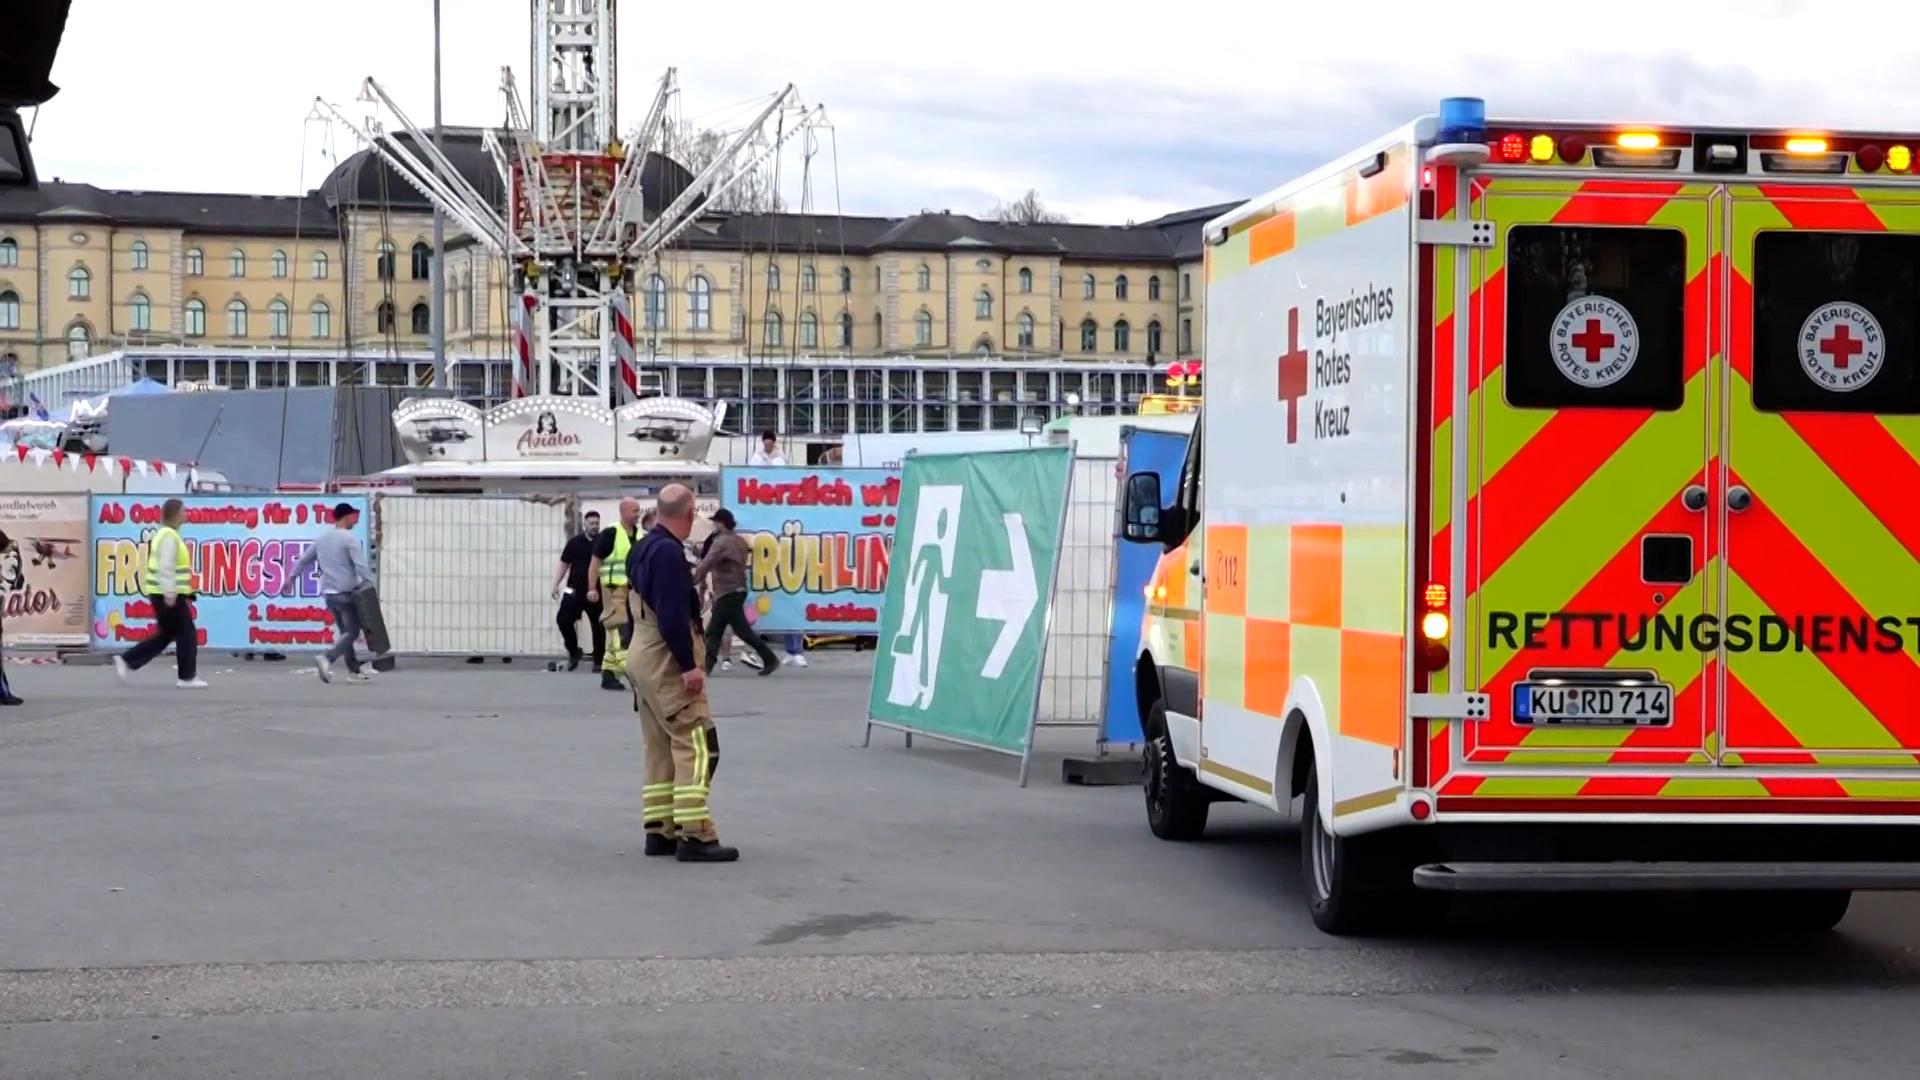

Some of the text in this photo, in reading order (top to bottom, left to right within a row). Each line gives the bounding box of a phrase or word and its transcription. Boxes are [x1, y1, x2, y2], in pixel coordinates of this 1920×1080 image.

[1316, 282, 1393, 343] Bayerisches
[1557, 303, 1632, 338] BAYERISCHES
[1805, 308, 1878, 343] BAYERISCHES
[1315, 349, 1350, 388] Rotes
[1557, 343, 1631, 379] ROTES KREUZ
[1805, 349, 1878, 384] ROTES KREUZ
[1314, 400, 1350, 439] Kreuz
[516, 428, 581, 450] Aviator
[738, 474, 852, 507] Herzlich
[98, 502, 125, 524] Ab
[129, 503, 258, 529] Ostsamstag
[735, 519, 894, 595] RÜHLIN
[1532, 689, 1564, 714] KU
[1581, 690, 1614, 715] RD
[1619, 691, 1665, 715] 714
